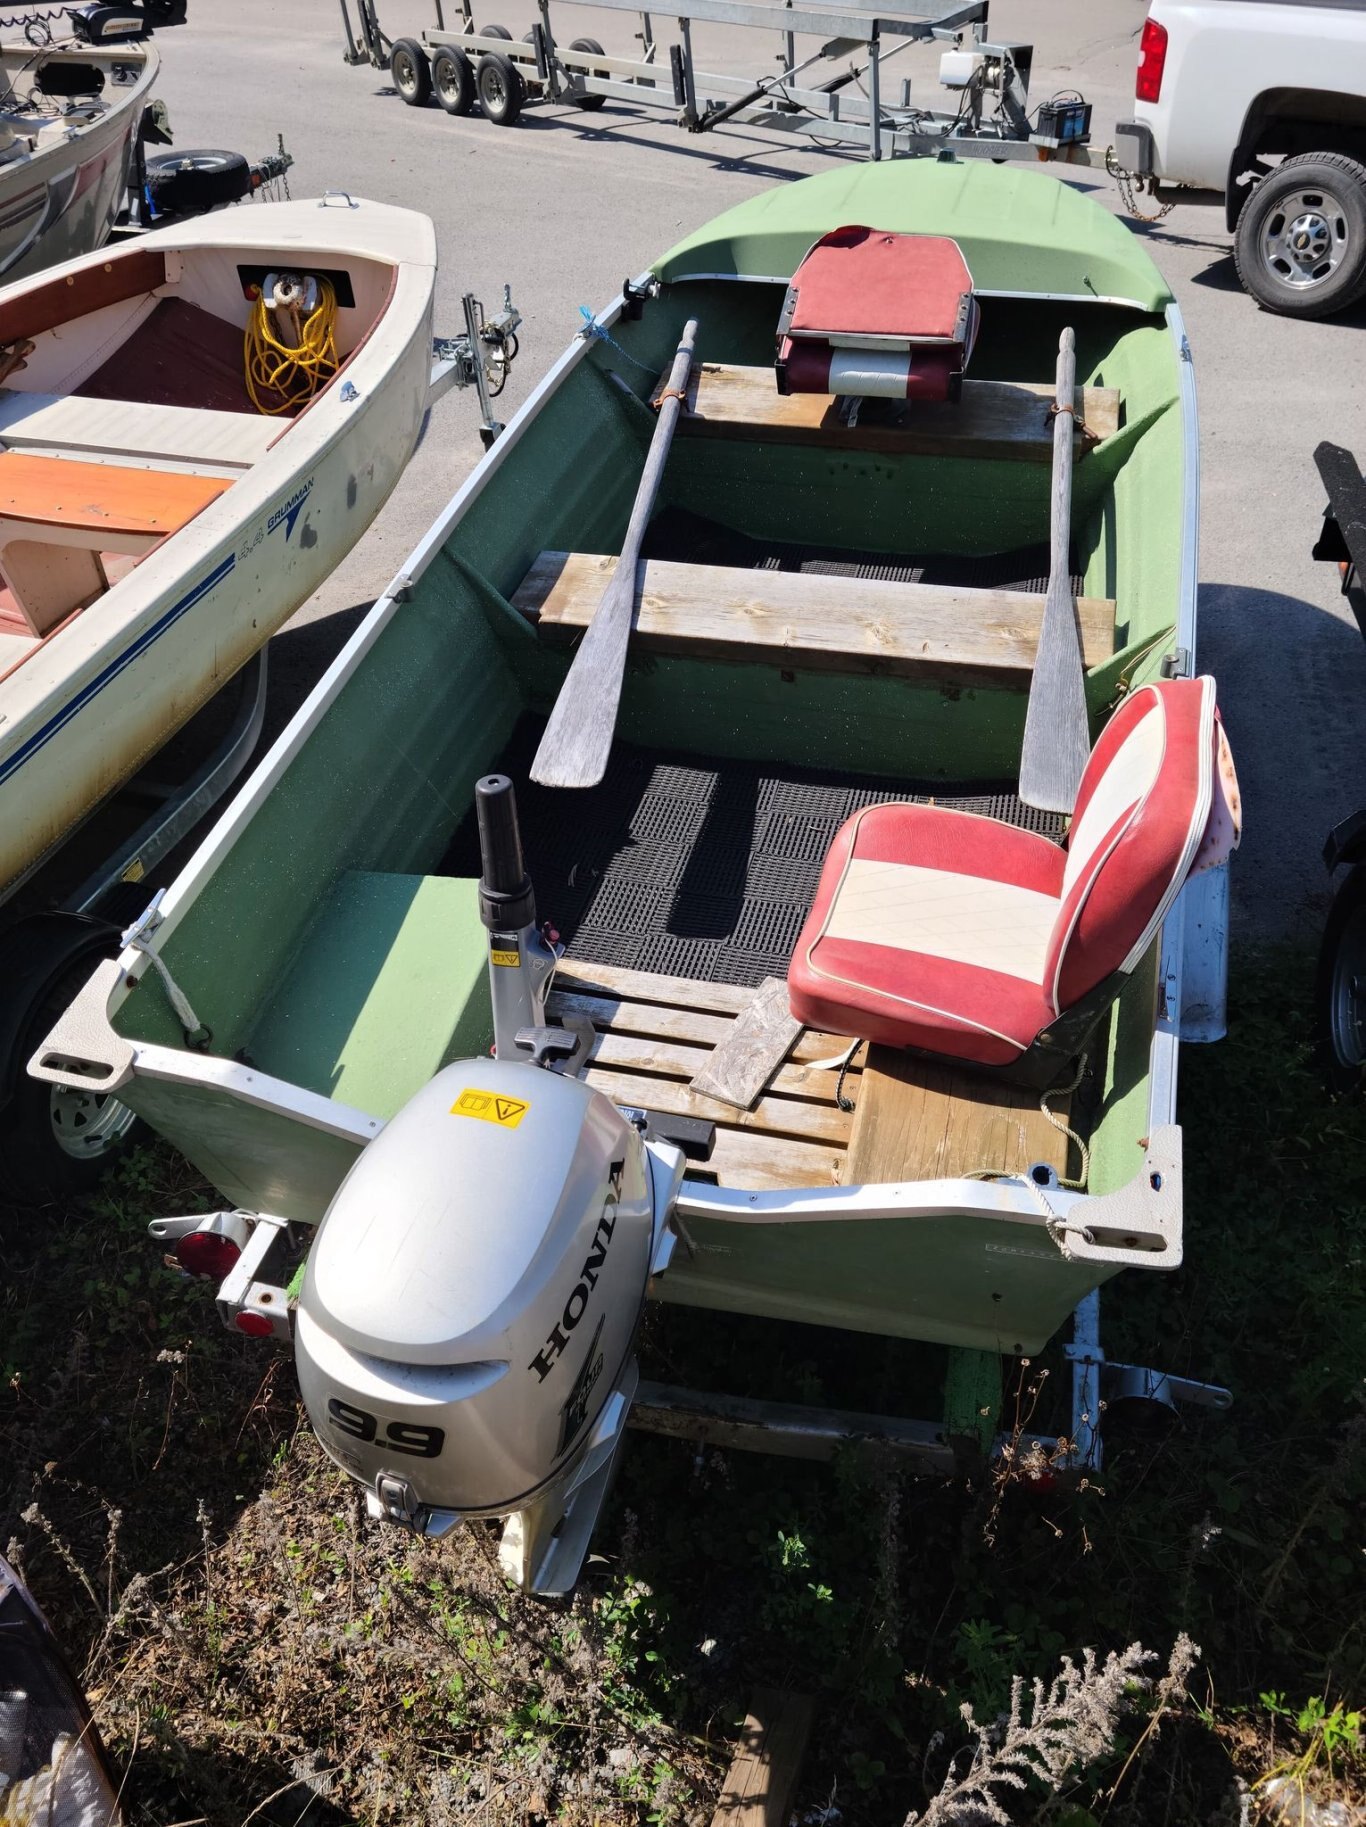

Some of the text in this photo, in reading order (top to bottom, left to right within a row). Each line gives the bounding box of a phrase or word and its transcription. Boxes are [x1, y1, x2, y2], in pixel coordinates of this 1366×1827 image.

[267, 476, 314, 529] GRUMMAN
[528, 1157, 625, 1384] HONDA
[327, 1398, 445, 1459] 9.9
